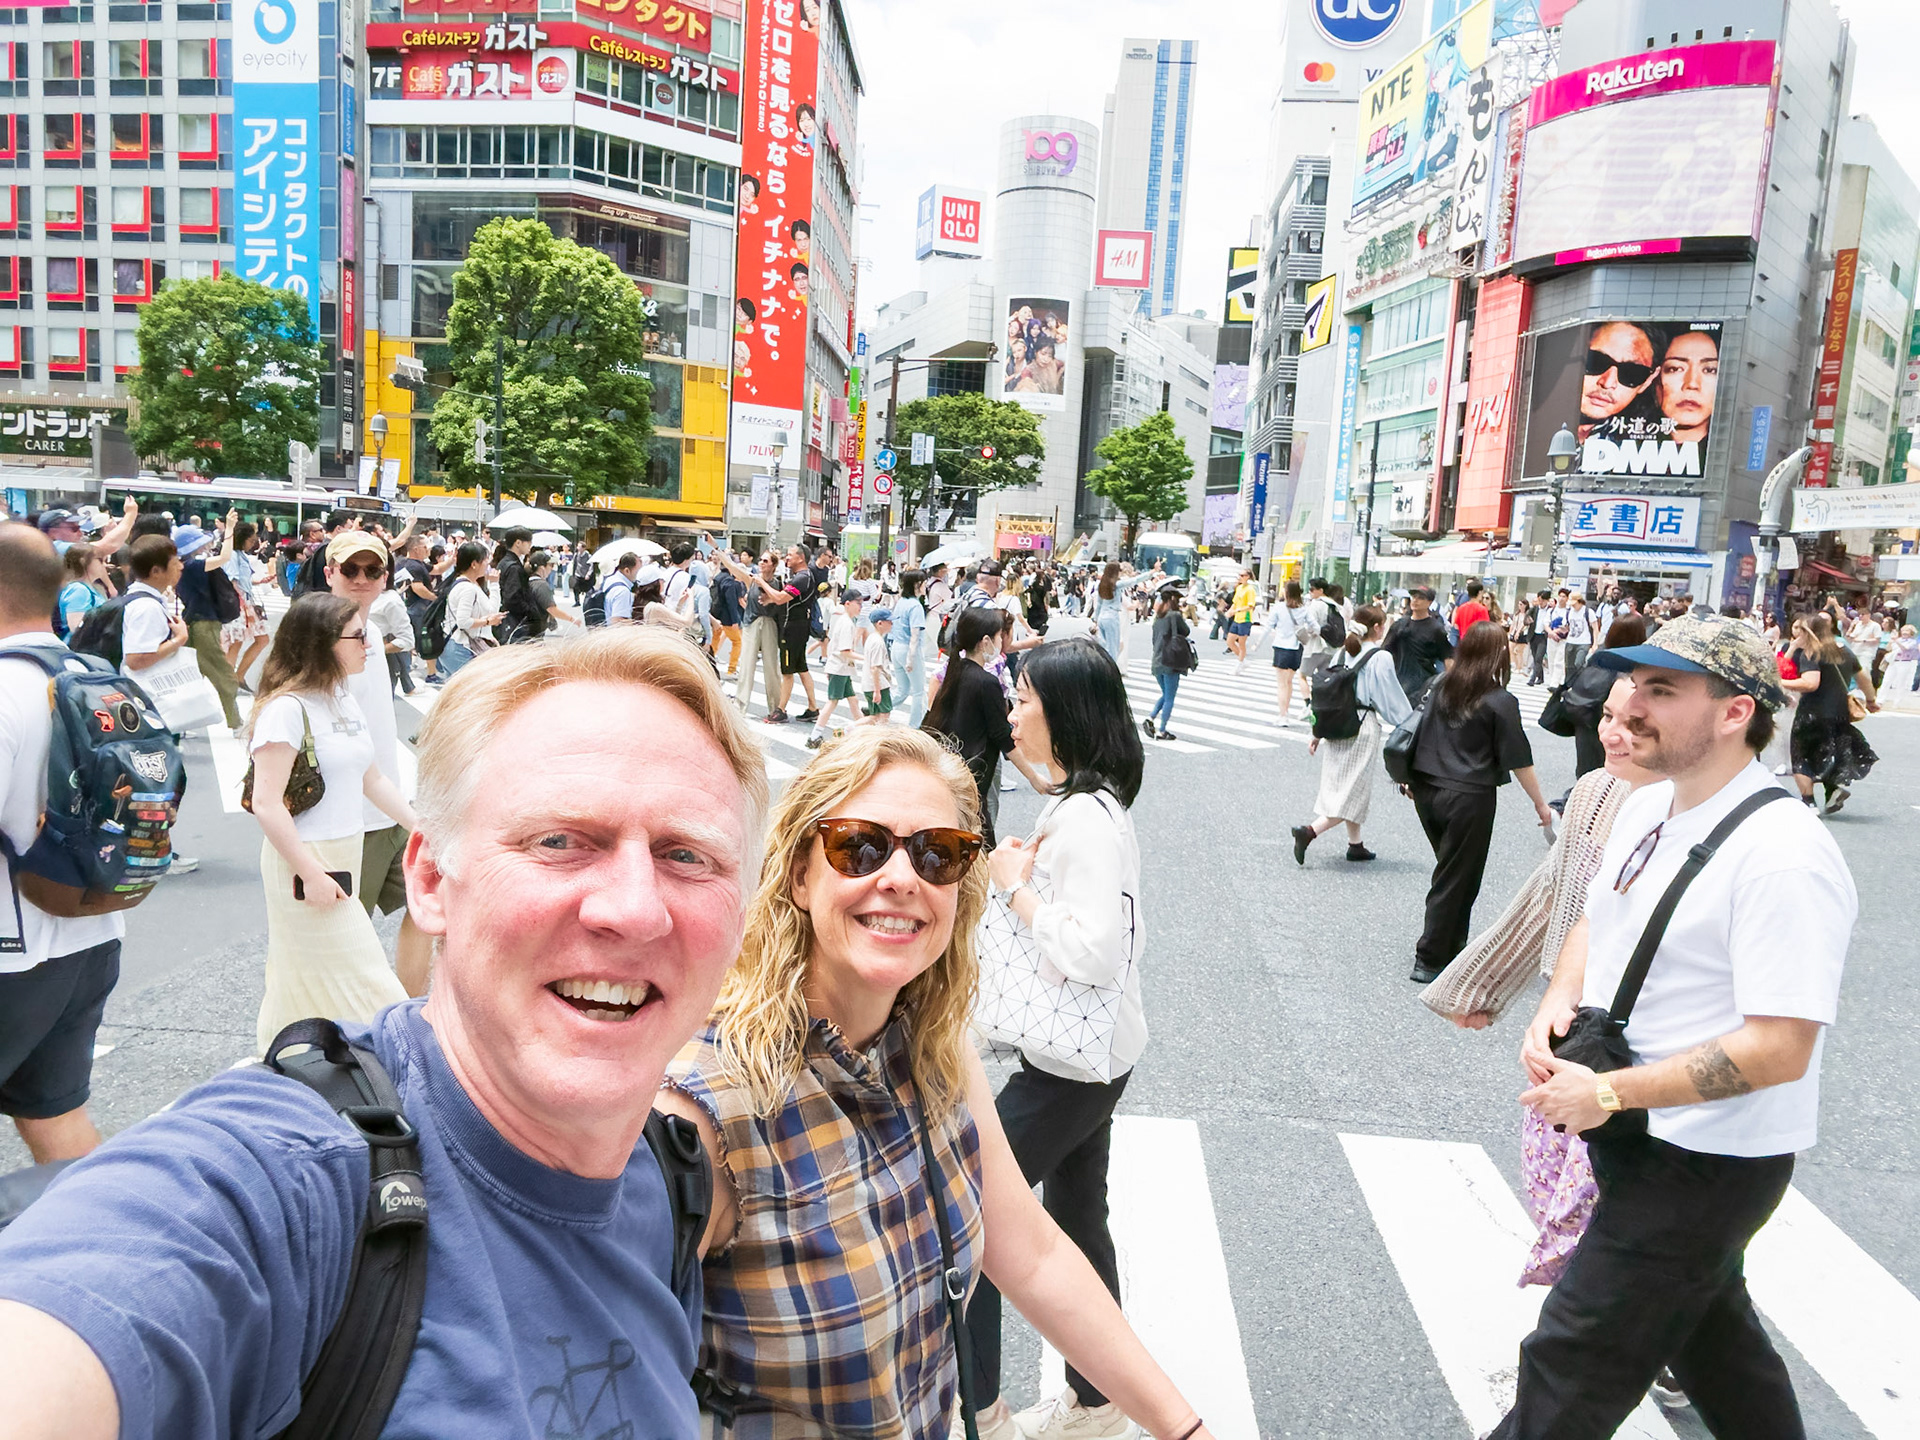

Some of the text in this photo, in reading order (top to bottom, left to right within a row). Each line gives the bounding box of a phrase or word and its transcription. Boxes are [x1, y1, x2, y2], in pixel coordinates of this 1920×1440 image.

[485, 23, 547, 50] ガスト
[243, 49, 308, 69] eyecity
[372, 67, 402, 87] 7F
[409, 66, 443, 82] Café
[446, 61, 525, 97] ガスト
[540, 72, 566, 83] ガスト
[670, 56, 728, 91] ガスト
[1586, 58, 1684, 95] Rakuten
[1371, 65, 1413, 120] NTE
[1022, 130, 1078, 176] 109
[1456, 66, 1494, 238] もんじゃ
[1023, 164, 1057, 175] SHIBUYA
[945, 201, 974, 221] UNI
[944, 220, 975, 238] QLO
[1110, 249, 1138, 268] H&M
[1587, 244, 1641, 259] Rakuten Vision
[1829, 253, 1854, 353] クスリのことなら
[1342, 347, 1359, 450] サマーフルーツギフト
[1609, 416, 1679, 435] 外道の歌
[24, 439, 65, 452] CARER
[748, 445, 779, 457] 17LIV
[1583, 438, 1701, 475] DMM
[1017, 536, 1032, 548] 109
[386, 1194, 428, 1213] Lowep
